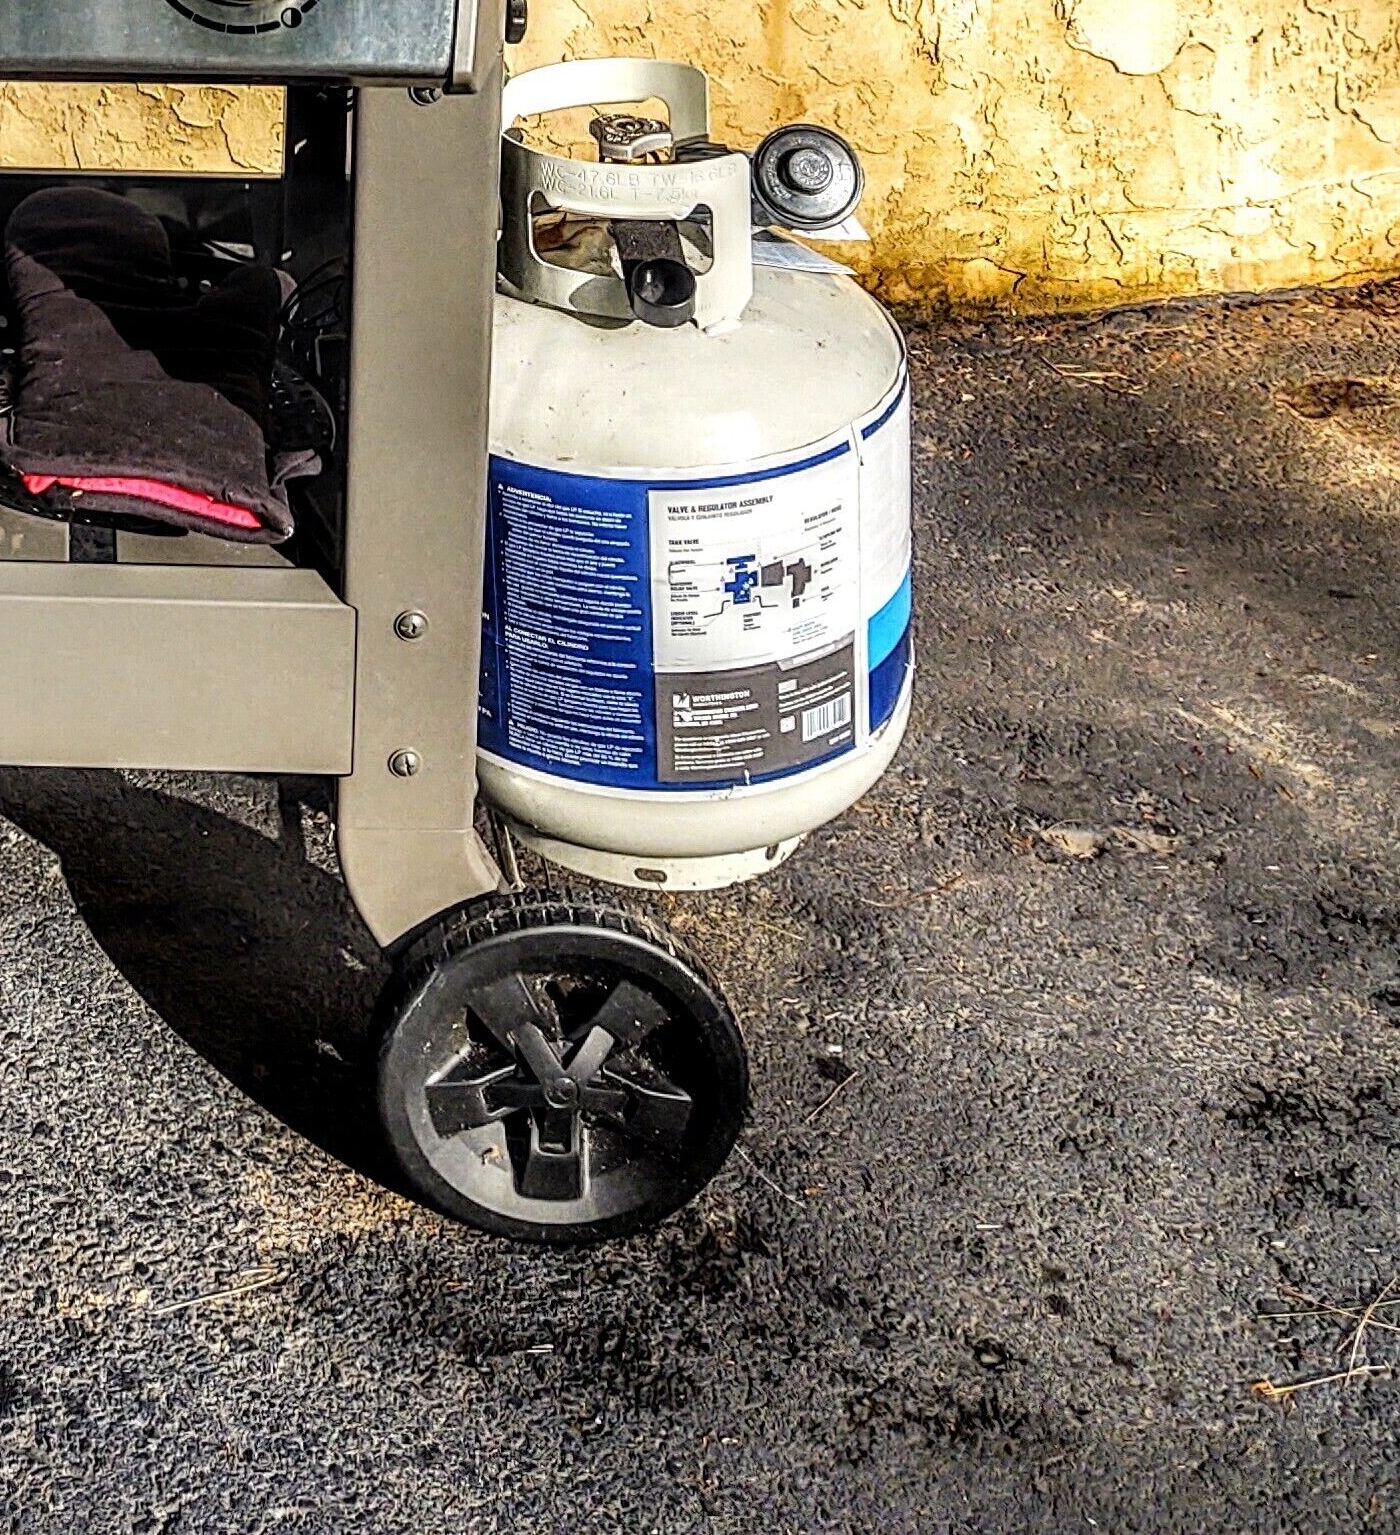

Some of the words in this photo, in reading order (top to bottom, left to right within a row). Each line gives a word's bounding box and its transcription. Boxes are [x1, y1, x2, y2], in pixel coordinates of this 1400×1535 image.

[668, 506, 688, 514] VALVE
[698, 502, 737, 512] REGULATOR
[739, 495, 773, 508] ASSEMBLY
[692, 690, 750, 702] WORTHINGTON
